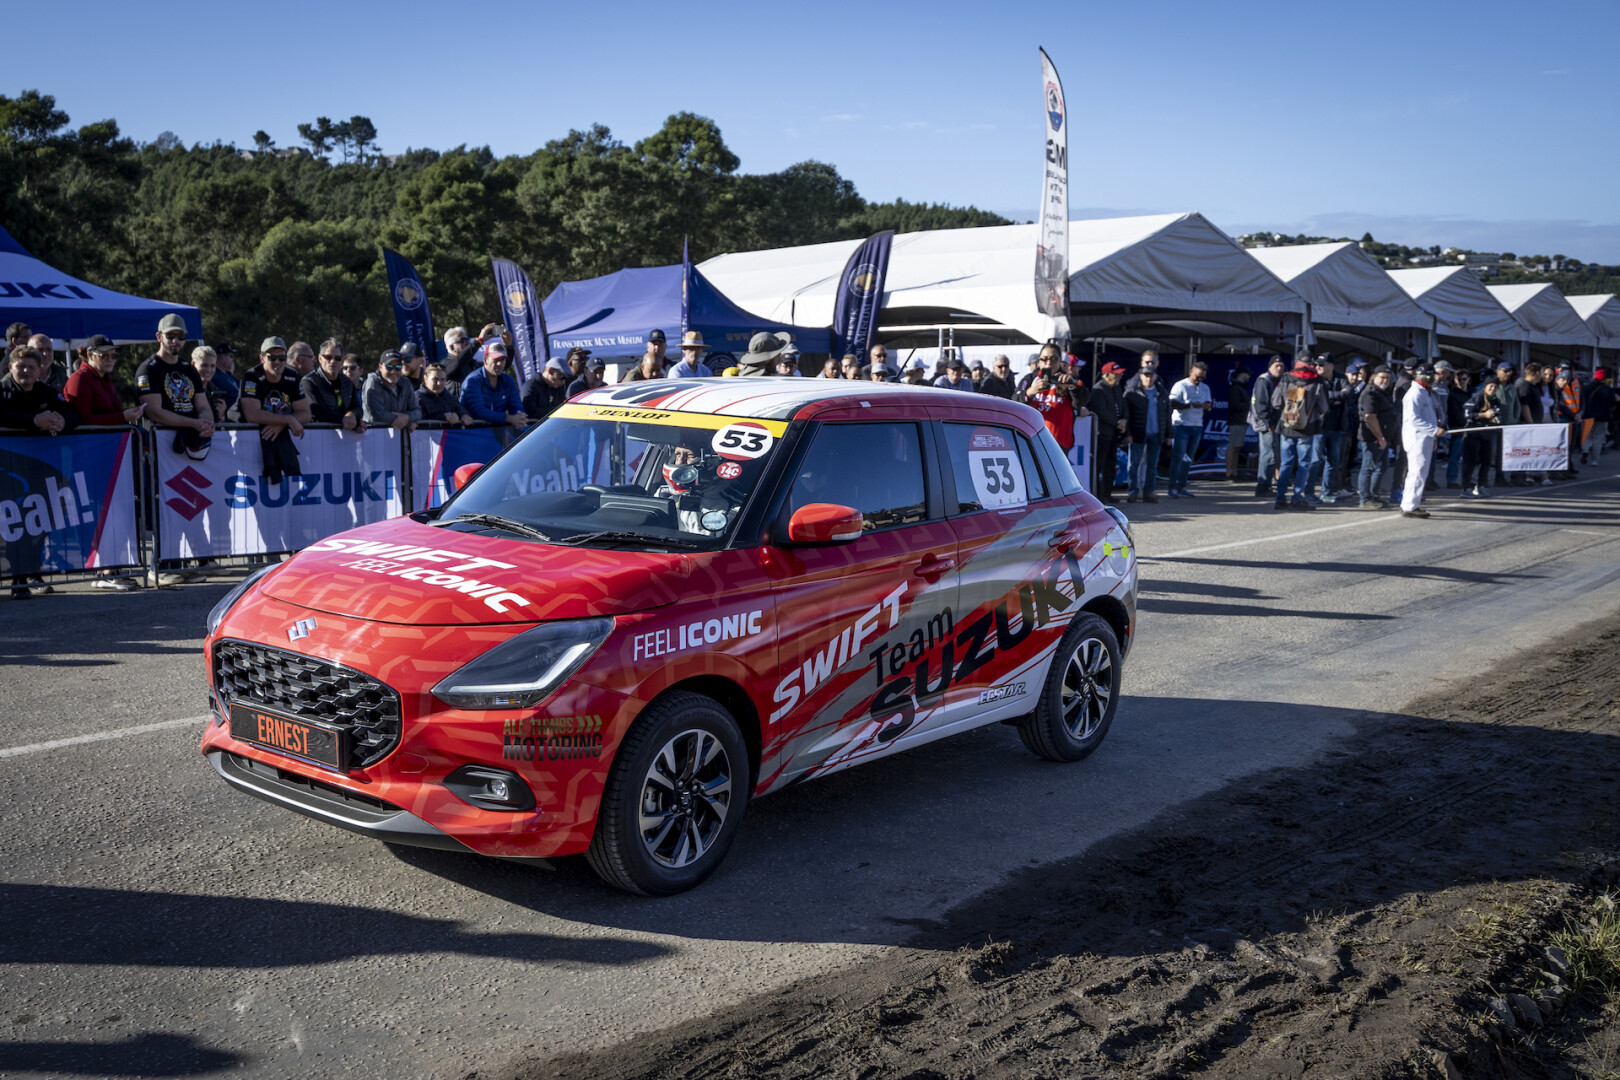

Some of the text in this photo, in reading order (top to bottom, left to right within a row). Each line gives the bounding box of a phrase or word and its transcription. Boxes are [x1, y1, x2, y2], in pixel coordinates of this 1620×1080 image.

[0, 282, 95, 300] UKI
[597, 409, 671, 419] DUNLOP
[1038, 403, 1051, 412] 39
[719, 430, 768, 452] 53
[224, 470, 394, 509] SUZUKI
[981, 457, 1015, 495] 53
[0, 470, 94, 543] eah!
[300, 538, 517, 572] SWIFT
[339, 558, 531, 614] FEEL ICONIC
[633, 610, 762, 661] FEEL ICONIC
[769, 580, 909, 724] SWIFT
[870, 547, 1085, 743] SUZUKI
[870, 606, 953, 687] Team
[977, 682, 1026, 705] ECSTAR
[257, 714, 309, 755] ERNEST
[503, 717, 574, 735] ALL THINGS
[503, 732, 603, 761] MOTORING
